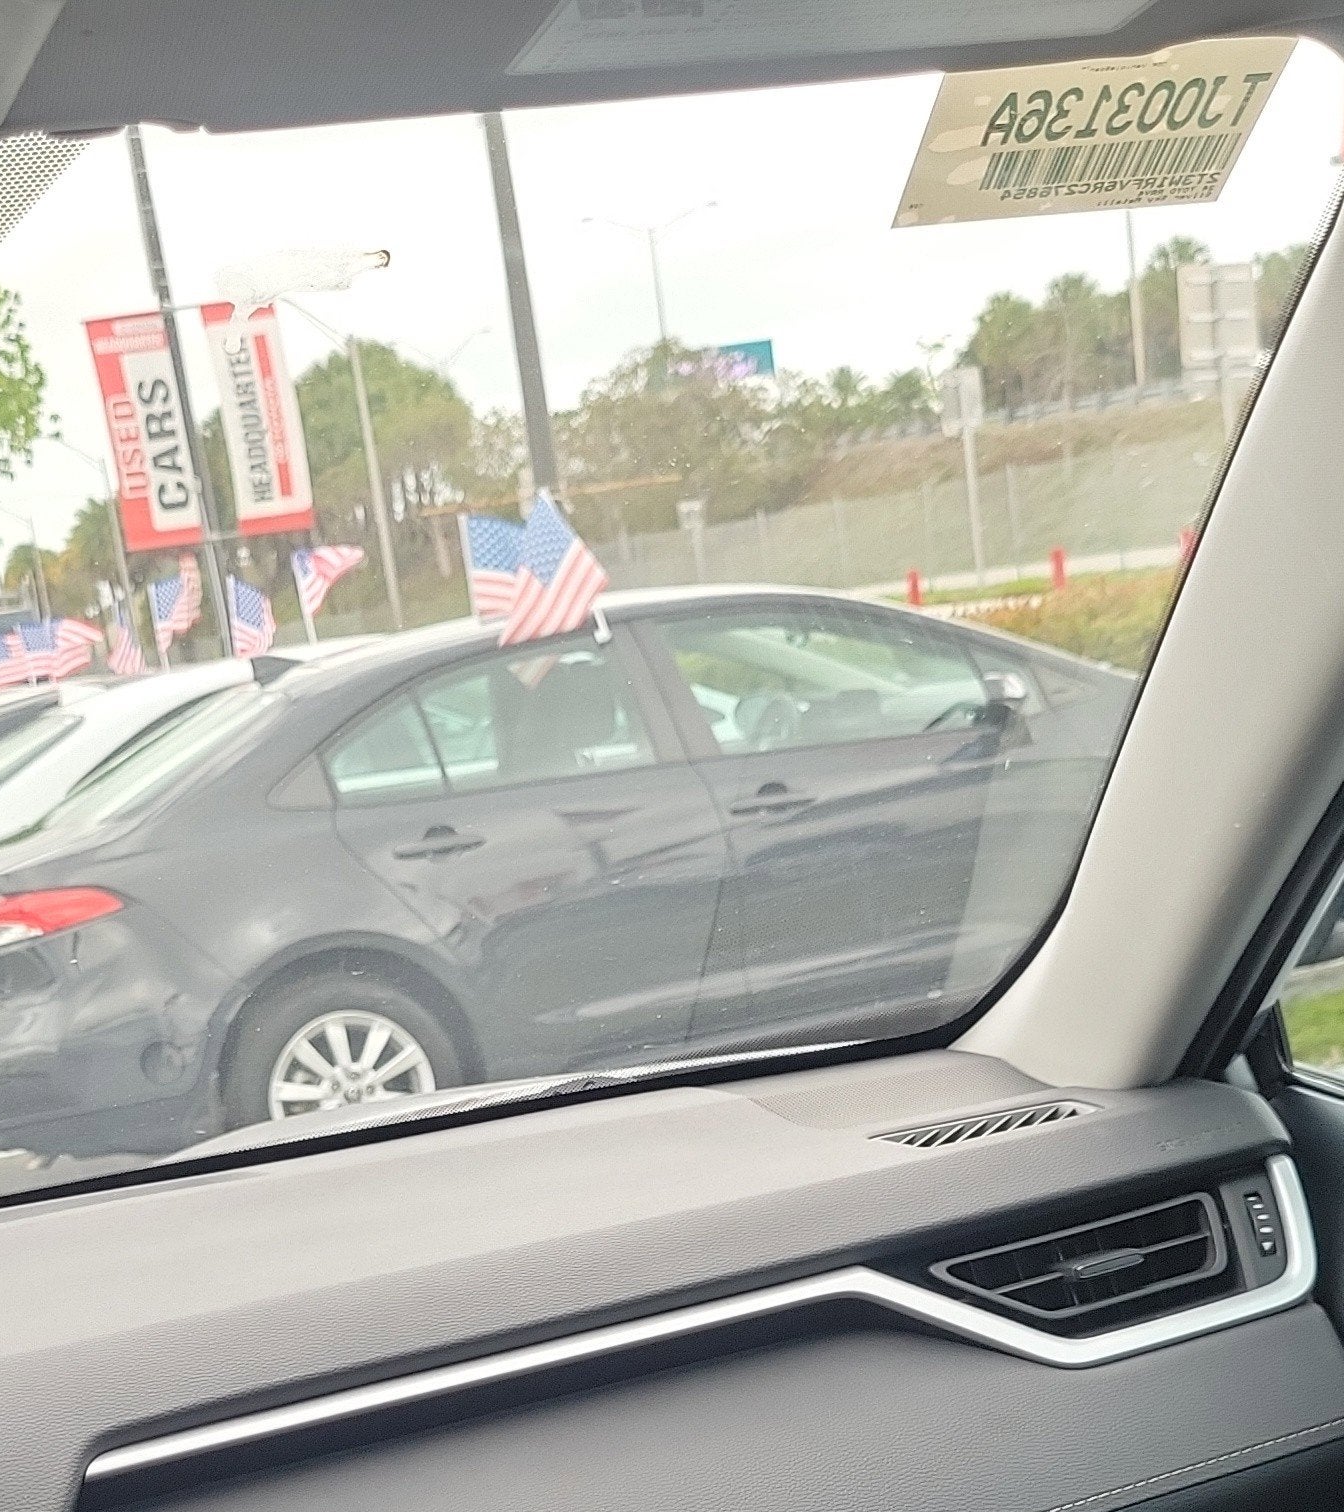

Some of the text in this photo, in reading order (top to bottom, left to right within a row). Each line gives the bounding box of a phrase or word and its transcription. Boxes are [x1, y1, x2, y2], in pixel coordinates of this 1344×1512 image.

[112, 400, 149, 497] USED
[136, 377, 190, 512] CARS
[227, 328, 274, 504] HEADQUARTE
